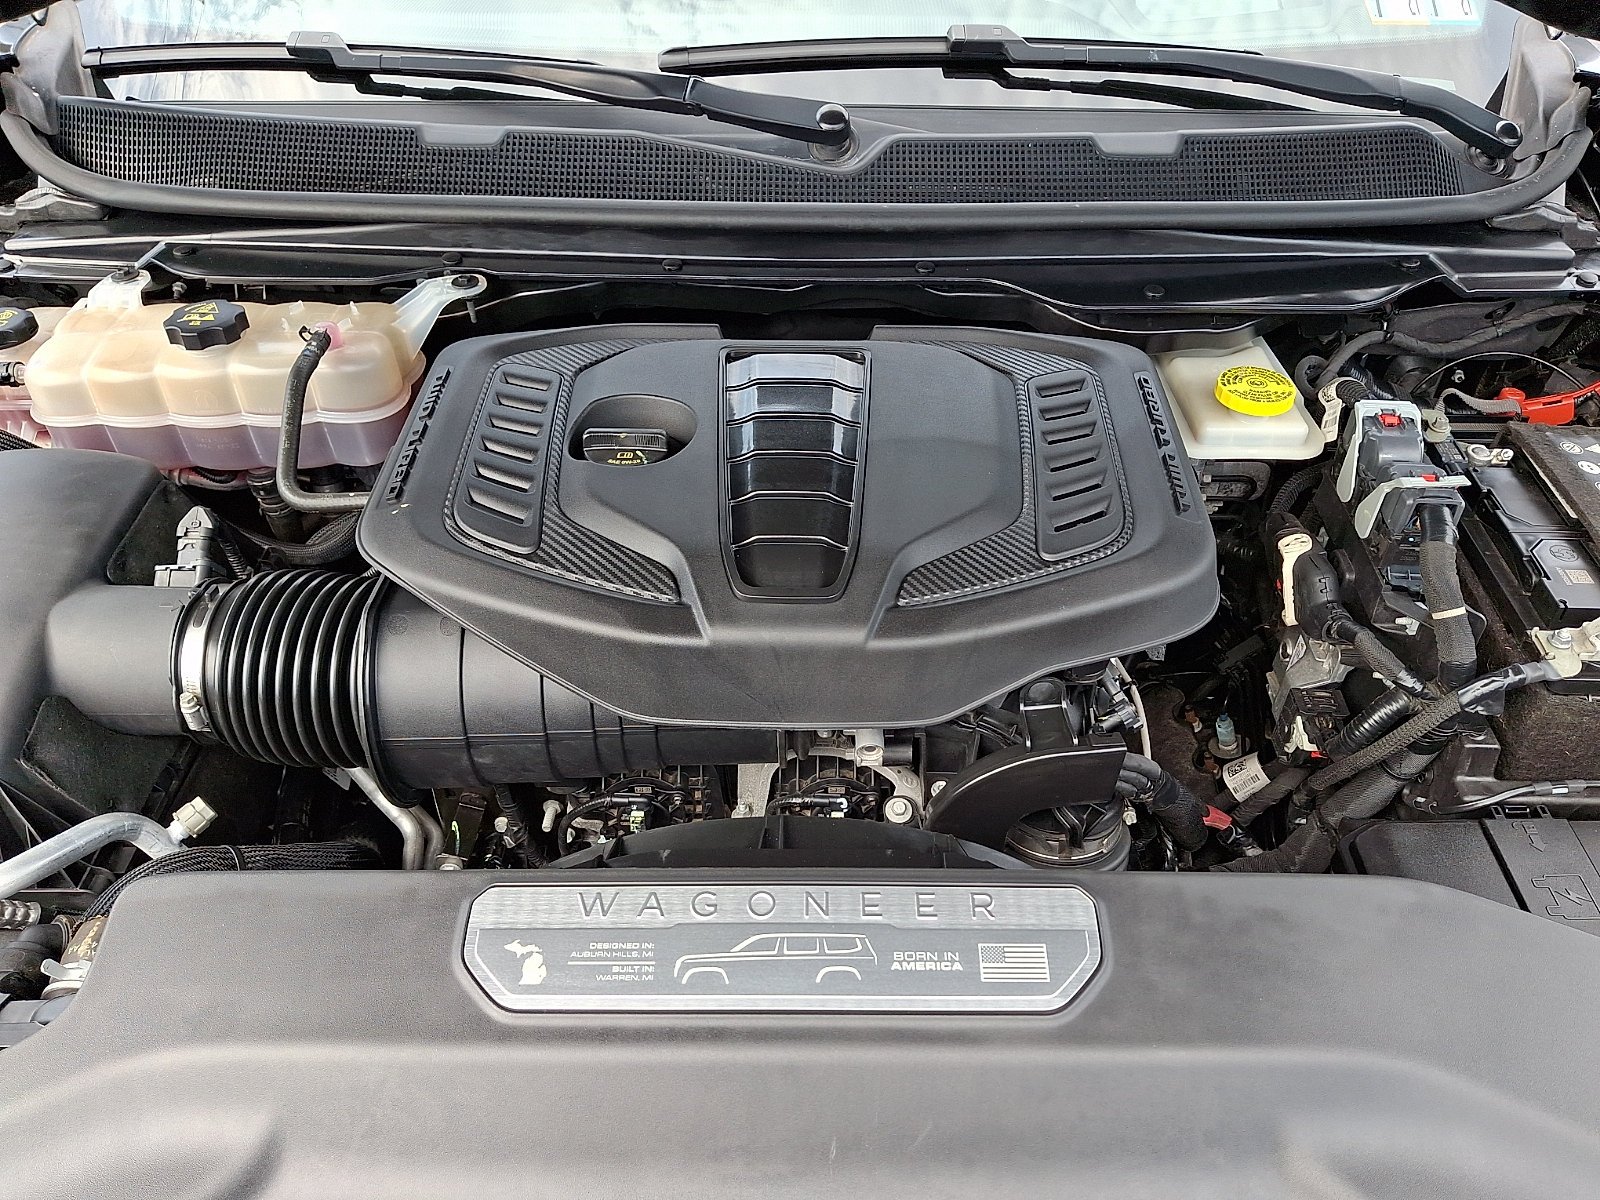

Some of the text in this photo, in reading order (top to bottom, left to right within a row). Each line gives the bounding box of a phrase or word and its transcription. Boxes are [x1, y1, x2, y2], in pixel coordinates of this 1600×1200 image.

[577, 890, 996, 919] WAGONEER
[589, 942, 640, 950] DESIGNED
[893, 951, 960, 961] BORN IN
[612, 965, 655, 973] BUILT IN:
[890, 961, 964, 971] AMERICA
[595, 974, 640, 982] WARREN,
